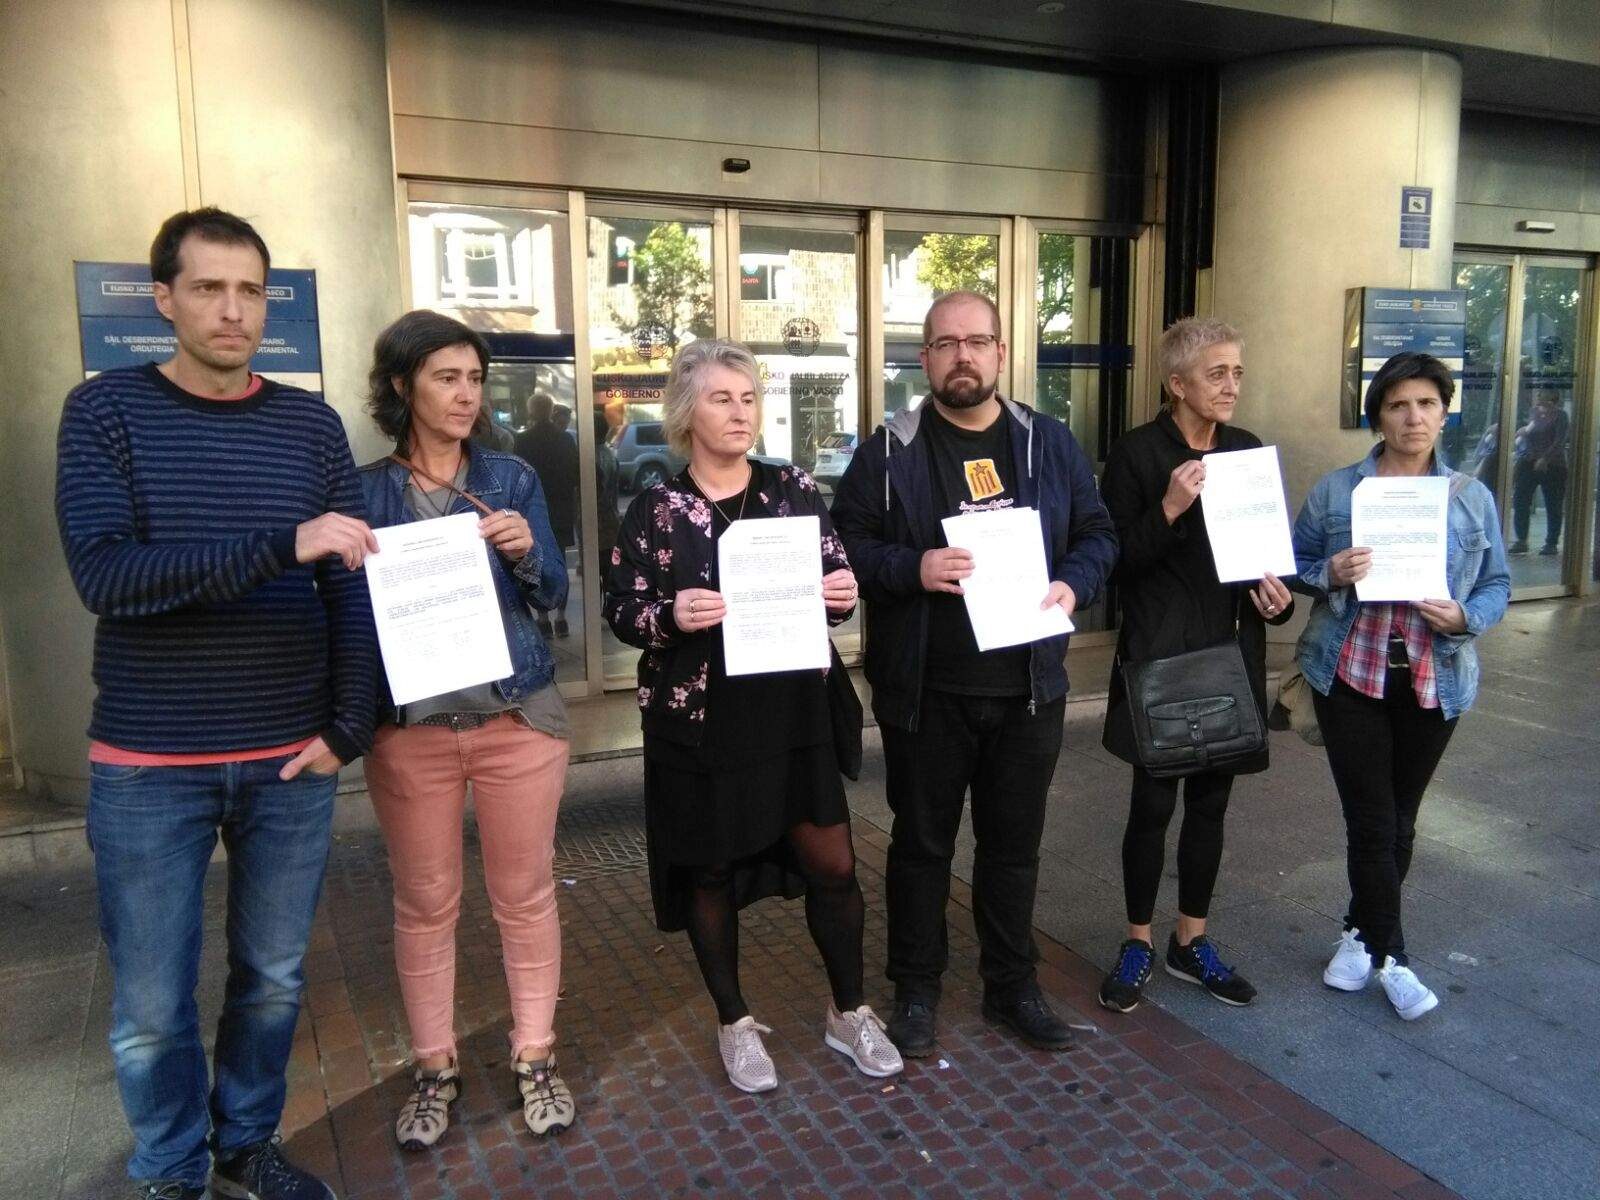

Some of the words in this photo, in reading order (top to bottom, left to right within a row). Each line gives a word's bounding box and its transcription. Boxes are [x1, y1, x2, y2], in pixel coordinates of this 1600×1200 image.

[265, 289, 286, 297] ASCO
[130, 345, 175, 353] ORDUTEGIA
[606, 389, 661, 399] GOBIERNO
[760, 386, 809, 395] GOBIERNO
[813, 386, 844, 396] VASCO
